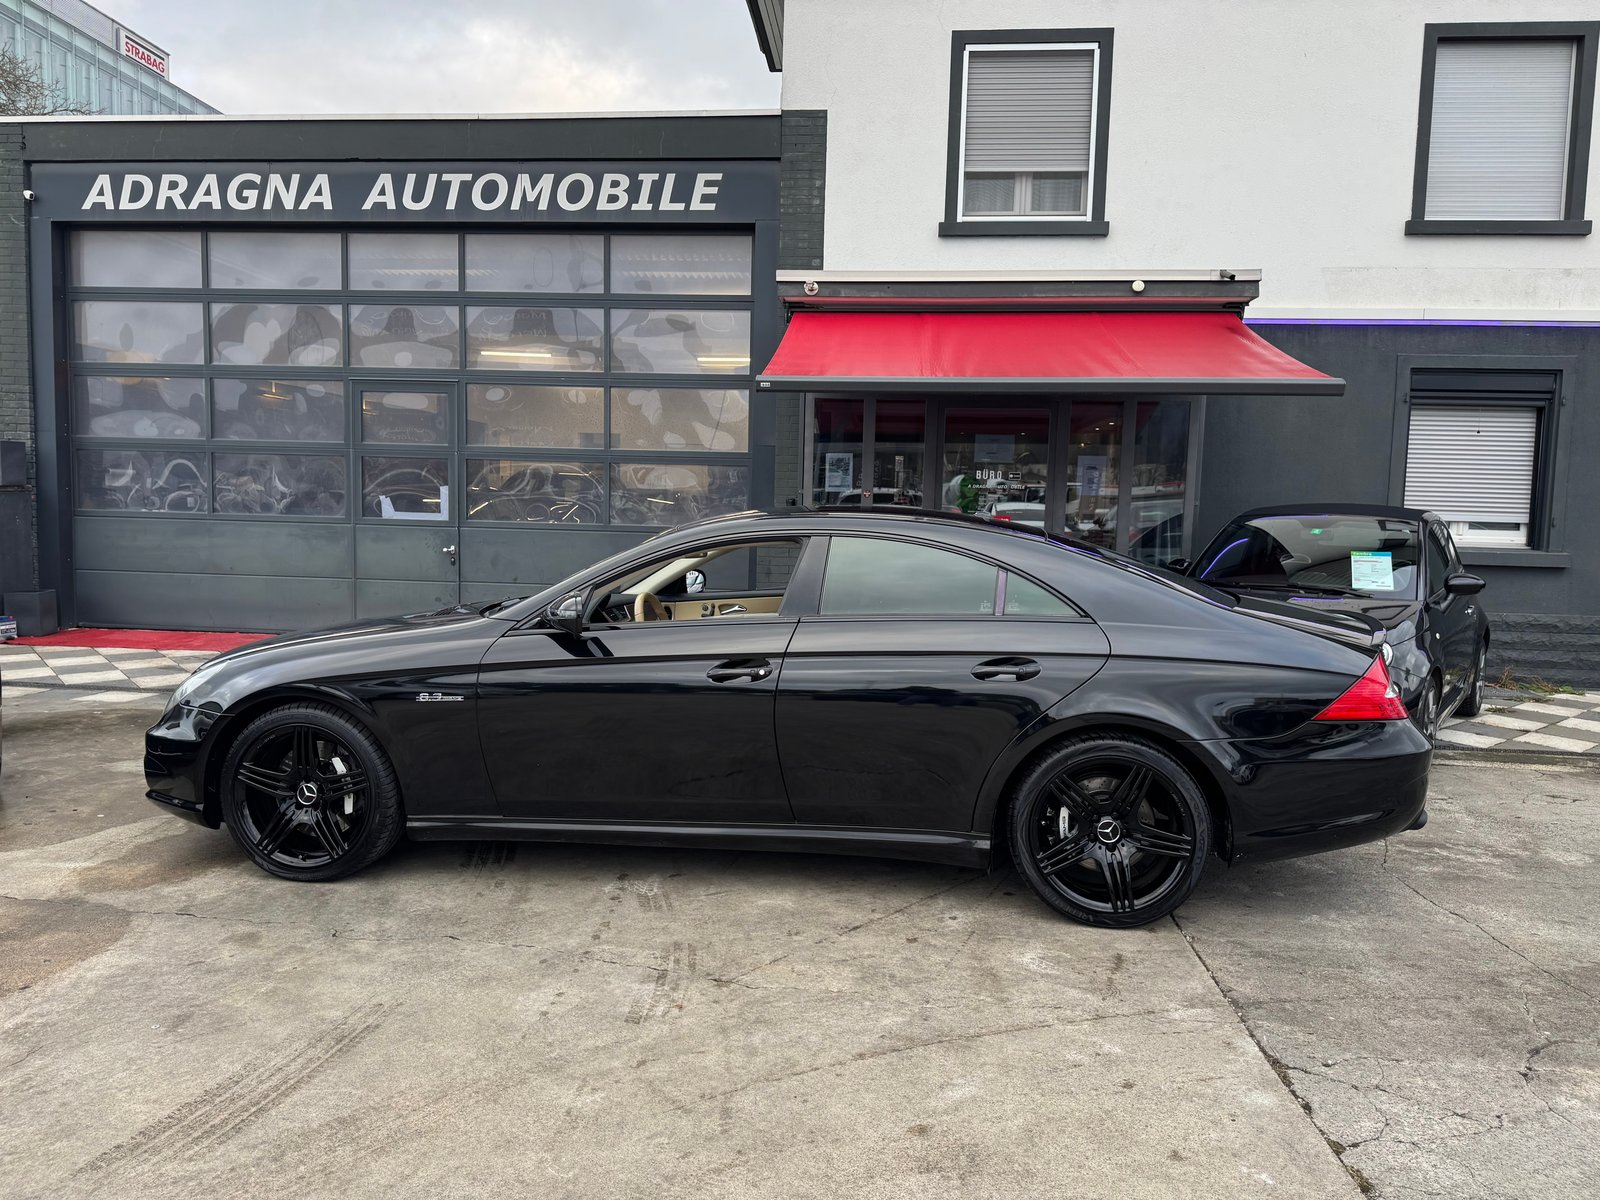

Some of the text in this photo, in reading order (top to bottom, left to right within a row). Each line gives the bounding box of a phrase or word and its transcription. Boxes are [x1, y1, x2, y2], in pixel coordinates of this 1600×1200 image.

[125, 41, 165, 73] STRABAG
[81, 172, 724, 212] ADRAGNA AUTOMOBILE
[977, 469, 1002, 480] BÜRO
